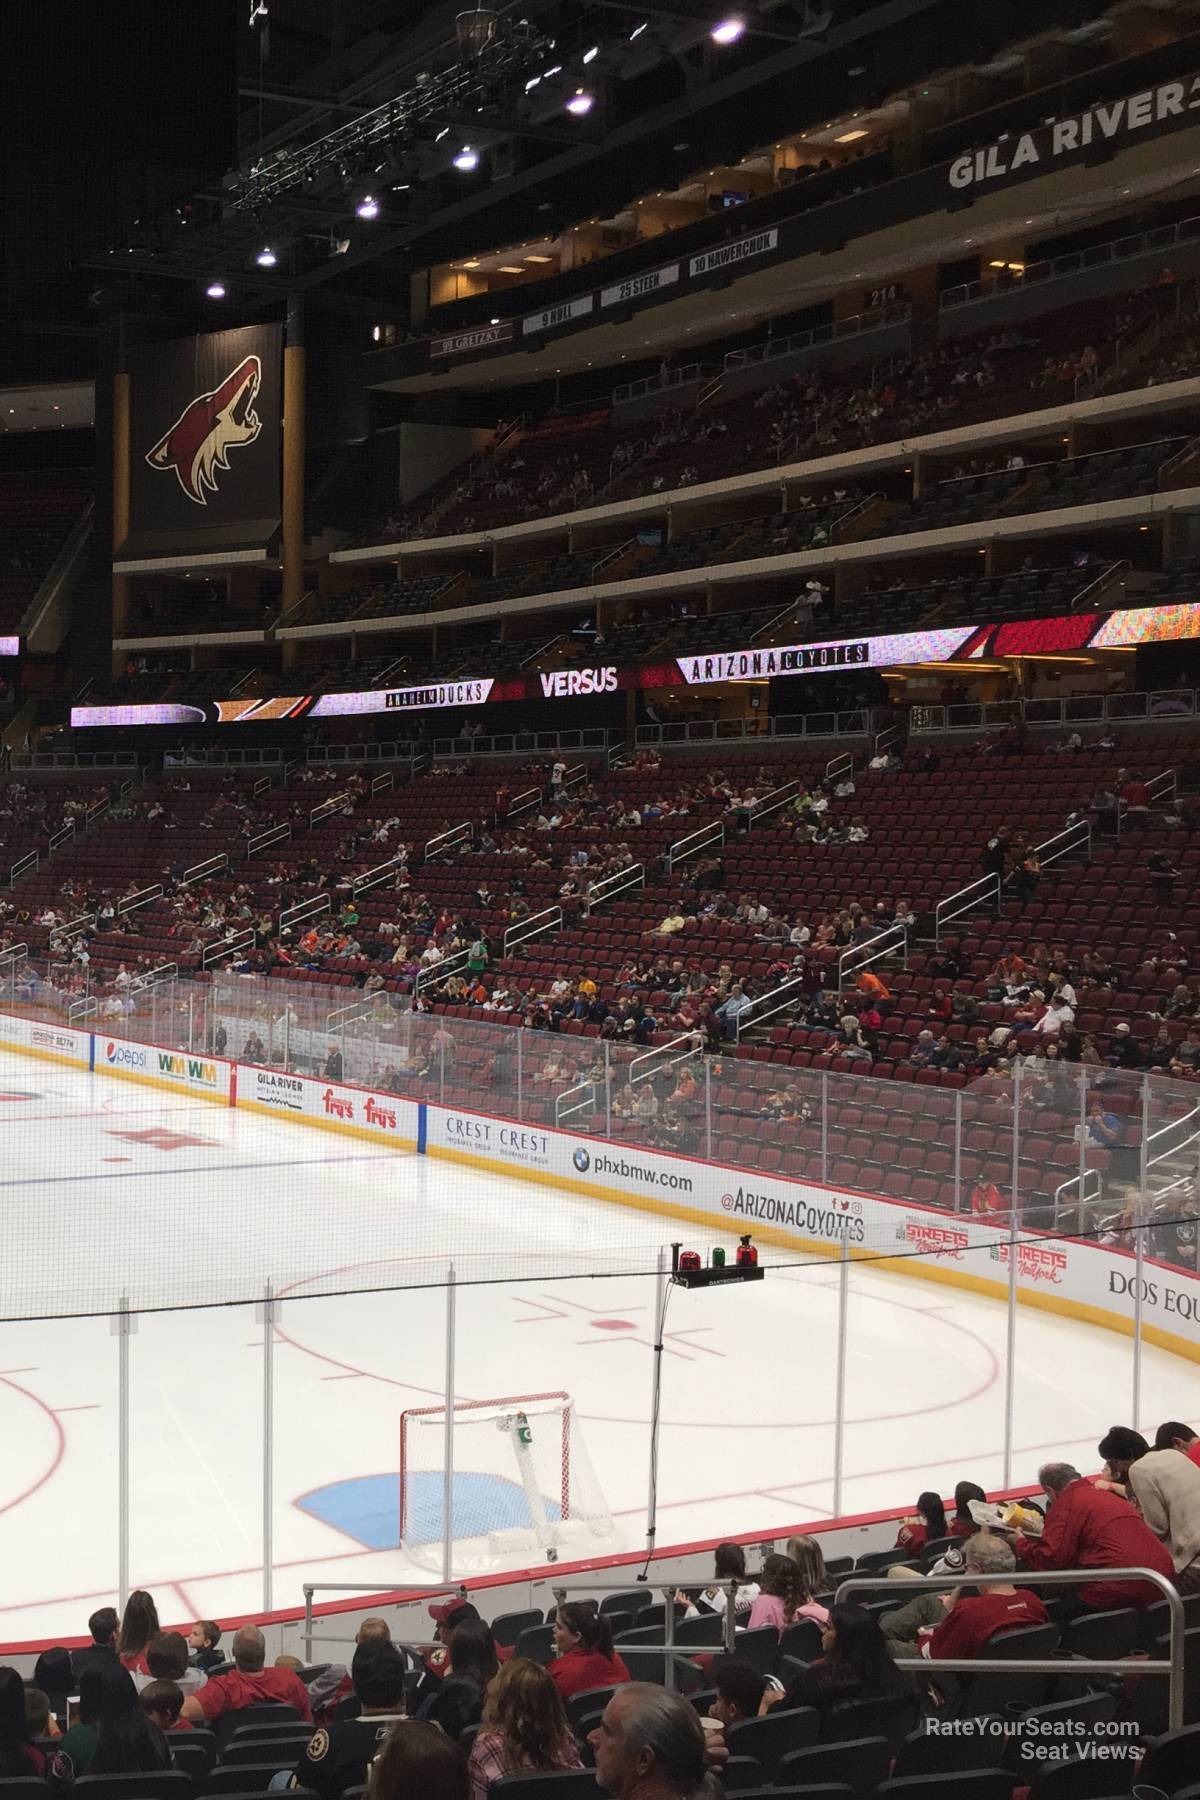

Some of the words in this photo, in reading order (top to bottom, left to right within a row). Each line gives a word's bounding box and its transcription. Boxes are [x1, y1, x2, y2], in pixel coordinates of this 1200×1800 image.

[949, 133, 1039, 189] GILA
[1052, 81, 1185, 155] RIVER
[707, 231, 771, 270] HAWERCHUK
[619, 283, 632, 299] 25
[633, 273, 660, 296] STEEN
[871, 285, 896, 306] 214
[541, 312, 549, 326] 9
[551, 305, 572, 322] HULL
[455, 328, 500, 350] GRETZKY
[691, 652, 776, 681] ARIZONA
[784, 645, 866, 669] COYOTES
[540, 666, 618, 698] VERSUS
[387, 690, 437, 708] ANAHEIM
[439, 683, 483, 705] DUCKS
[117, 1047, 147, 1068] pepsi
[257, 1073, 277, 1087] GILA
[277, 1076, 303, 1092] RIVER
[446, 1117, 491, 1140] CREST
[500, 1128, 549, 1153] CREST
[594, 1156, 693, 1192] phxbmw.com
[906, 1224, 969, 1248] STREETS
[1000, 1243, 1067, 1270] STREETS
[1109, 1270, 1158, 1306] DOS
